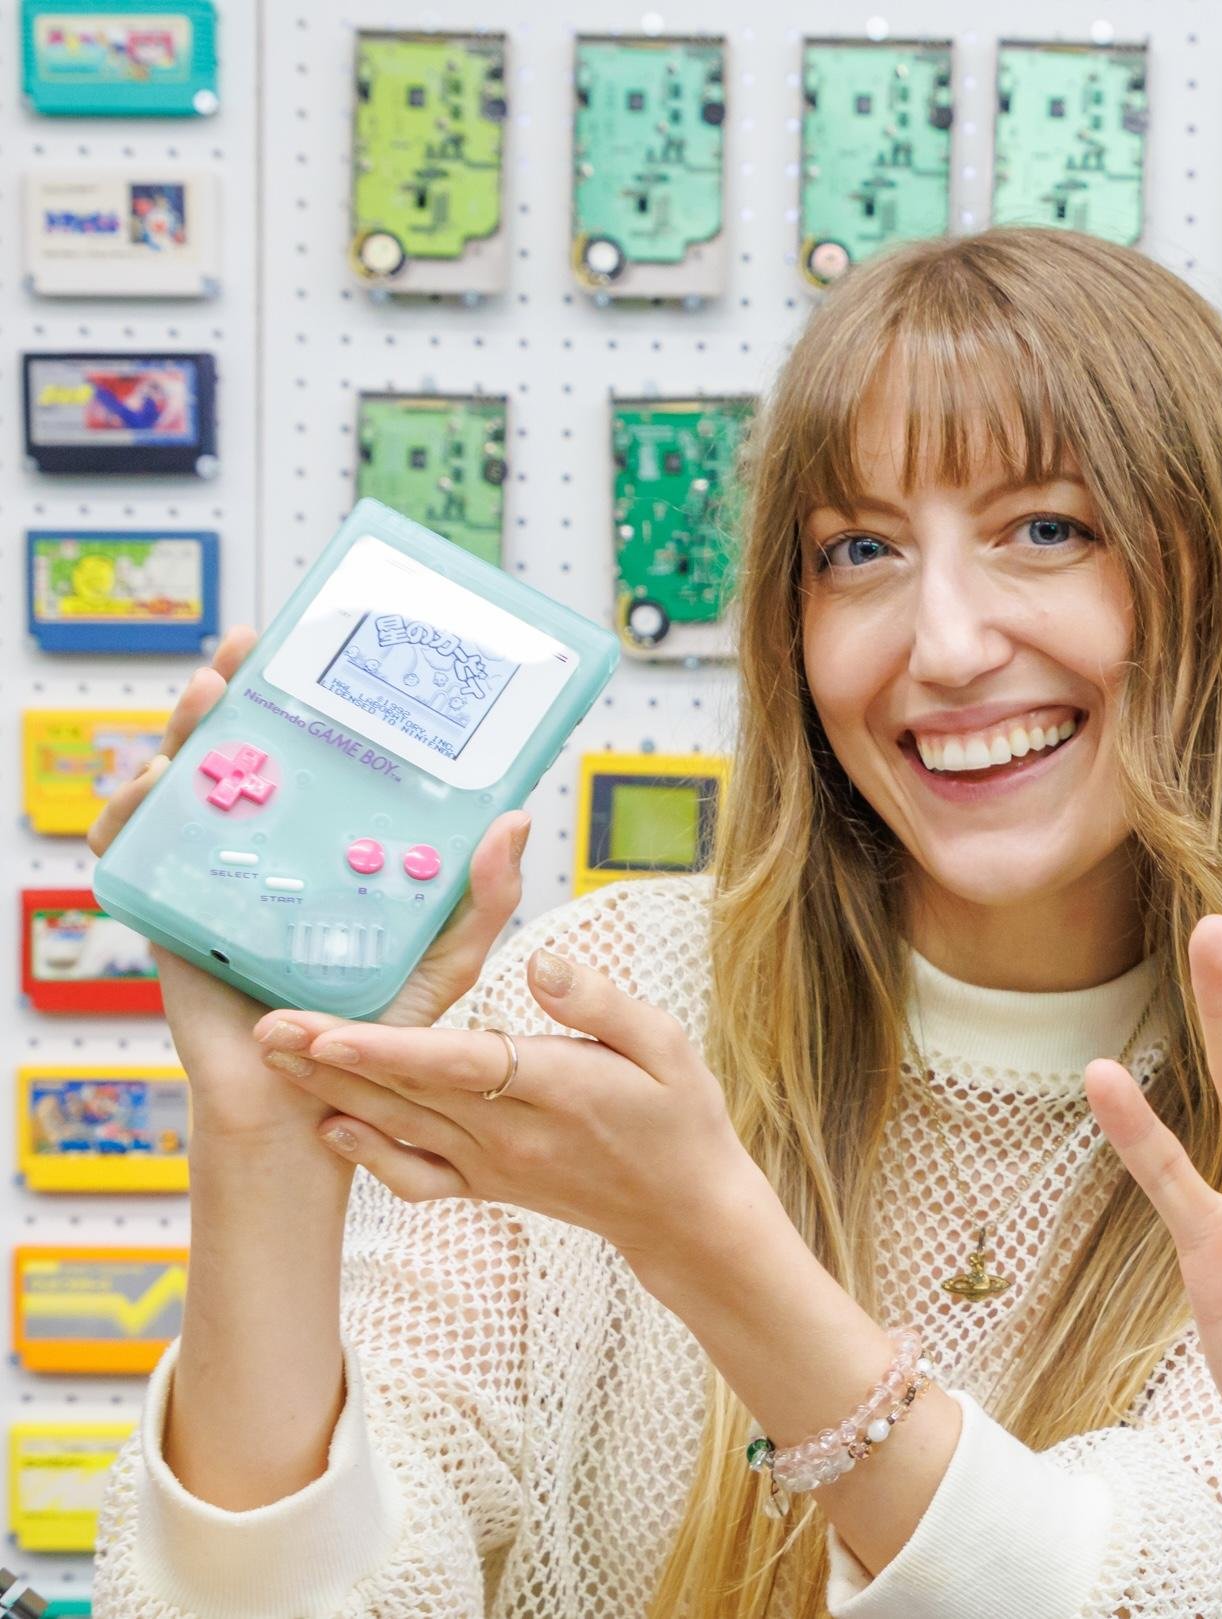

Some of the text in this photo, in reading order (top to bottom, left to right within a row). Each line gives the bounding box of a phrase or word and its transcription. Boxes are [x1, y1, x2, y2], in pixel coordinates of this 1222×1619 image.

[243, 688, 307, 729] Nintendo
[308, 721, 363, 758] GAME
[381, 714, 396, 726] TO
[209, 869, 259, 879] SELECT
[260, 895, 303, 904] START
[358, 887, 425, 901] B A
